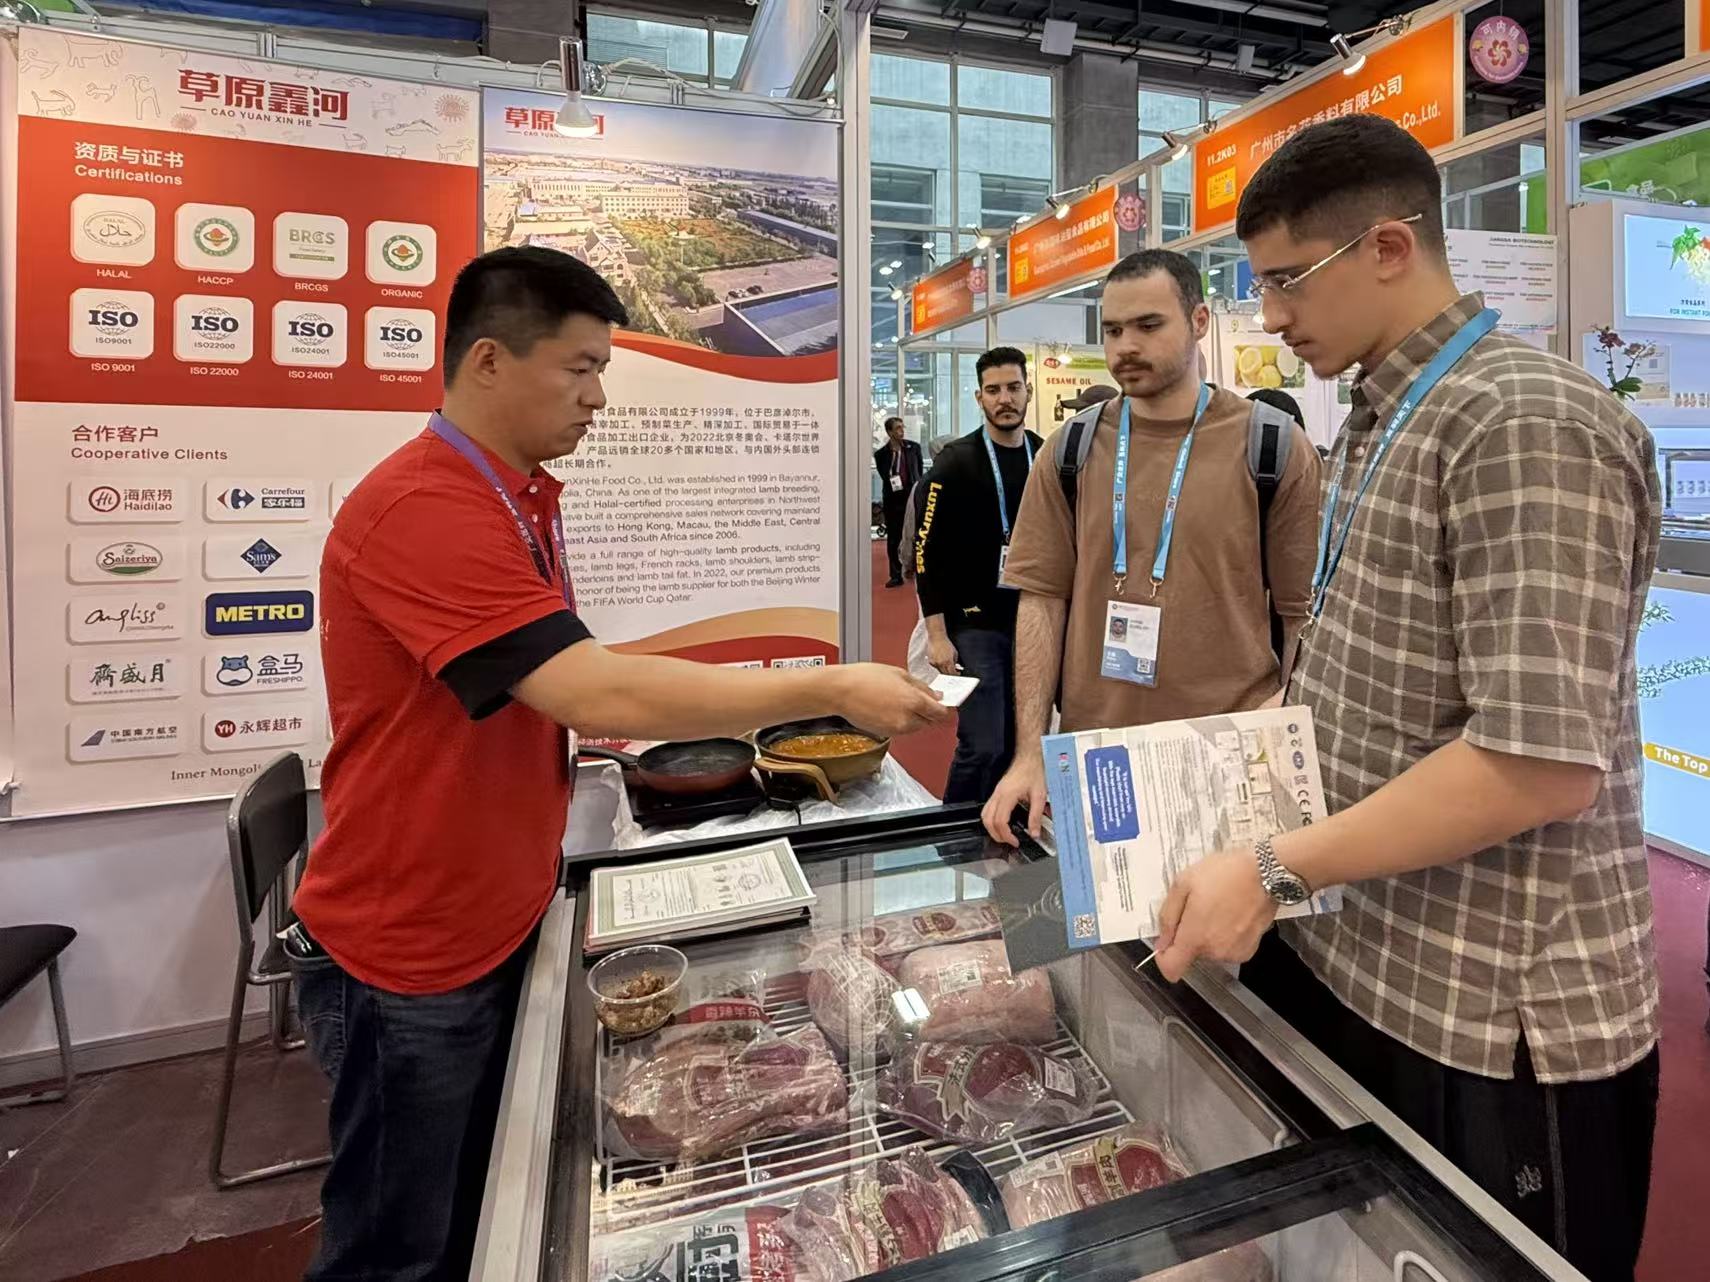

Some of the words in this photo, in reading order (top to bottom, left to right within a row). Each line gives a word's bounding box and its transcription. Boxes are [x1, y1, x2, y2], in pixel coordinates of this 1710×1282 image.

[177, 69, 350, 121] 草原鑫河
[210, 108, 236, 118] CAO
[241, 111, 271, 122] YUAN
[274, 115, 295, 126] XIN
[298, 118, 312, 127] HE
[505, 107, 604, 135] 草原
[74, 141, 183, 169] 资质与证书
[1206, 143, 1237, 167] 11.2K03
[74, 164, 183, 186] Certifications
[99, 223, 132, 238] حلال
[96, 269, 132, 279] HALAL
[197, 275, 234, 285] HACCP
[294, 282, 328, 292] BRCGS
[381, 288, 423, 298] ORGANIC
[88, 309, 138, 328] ISO
[191, 315, 239, 333] ISO
[288, 321, 333, 338] ISO
[380, 326, 423, 343] ISO
[95, 337, 132, 345] ISO9001
[194, 342, 235, 350] ISO22000
[291, 347, 330, 355] ISO24001
[383, 351, 419, 359] ISO45001
[91, 363, 110, 371] ISO
[112, 364, 135, 372] 9001
[190, 367, 208, 375] ISO
[209, 367, 239, 376] 22000
[288, 370, 305, 378] ISO
[307, 371, 333, 379] 24001
[380, 374, 396, 382] ISO
[397, 374, 422, 383] 45001
[1046, 377, 1077, 385] SESAME
[71, 425, 159, 443] 合作客户
[71, 447, 170, 461] Cooperative
[174, 448, 228, 461] Clients
[563, 476, 600, 485] anXinHe
[602, 476, 626, 485] Food
[666, 476, 685, 485] was
[686, 474, 736, 483] established
[737, 475, 745, 483] in
[747, 474, 768, 482] 1999
[769, 474, 777, 482] in
[123, 489, 172, 501] 海底捞
[561, 489, 582, 498] olia,
[618, 488, 630, 497] As
[652, 487, 662, 495] of
[664, 487, 679, 495] the
[680, 487, 711, 496] largest
[713, 486, 757, 495] integrated
[759, 485, 780, 494] lamb
[123, 502, 172, 511] Haidilao
[571, 500, 590, 509] and
[594, 498, 662, 508] Halal-certified
[665, 498, 713, 508] processing
[717, 498, 765, 506] enterprises
[778, 496, 821, 504] Northwest
[584, 511, 604, 520] built
[614, 510, 683, 521] comprehensive
[685, 510, 708, 518] sales
[710, 508, 746, 517] network
[746, 507, 782, 517] covering
[784, 506, 821, 515] mainland
[918, 481, 943, 541] Luxury
[566, 524, 601, 534] exports
[605, 523, 615, 532] to
[617, 522, 643, 533] Hong
[714, 519, 729, 528] the
[731, 518, 761, 528] Middle
[789, 517, 821, 526] Central
[586, 535, 608, 545] Asia
[610, 534, 629, 543] and
[631, 533, 658, 543] South
[660, 532, 687, 542] Africa
[689, 531, 714, 541] since
[590, 552, 597, 560] a
[600, 550, 614, 559] full
[617, 550, 644, 560] range
[647, 548, 656, 557] of
[659, 547, 712, 558] high-quality
[715, 545, 738, 554] lamb
[785, 543, 821, 552] including
[102, 552, 158, 566] Saizeriya
[590, 562, 614, 571] lamb
[641, 560, 674, 569] French
[705, 557, 727, 566] lamb
[775, 554, 796, 563] lamb
[572, 575, 615, 584] nderloins
[617, 574, 635, 582] and
[637, 572, 660, 581] lamb
[661, 571, 674, 579] tail
[693, 570, 702, 578] In
[746, 567, 783, 577] premium
[785, 565, 821, 574] products
[575, 587, 603, 596] honor
[604, 586, 614, 594] of
[615, 585, 641, 594] being
[642, 584, 657, 592] the
[658, 583, 680, 591] lamb
[681, 581, 715, 591] supplier
[717, 580, 728, 588] for
[730, 579, 749, 588] both
[750, 578, 765, 586] the
[765, 576, 793, 586] Beijing
[794, 575, 821, 584] Winter
[576, 599, 591, 608] the
[593, 598, 616, 607] FIFA
[617, 596, 644, 605] World
[645, 595, 665, 604] Cup
[216, 603, 305, 622] METRO
[257, 653, 303, 676] 盒马
[256, 675, 303, 685] FRESHIPPO
[110, 726, 178, 738] 中国南方航空
[239, 717, 303, 735] 永辉超市
[1654, 746, 1680, 764] The
[1681, 754, 1708, 774] Top
[171, 769, 206, 780] Inner
[308, 758, 323, 769] La
